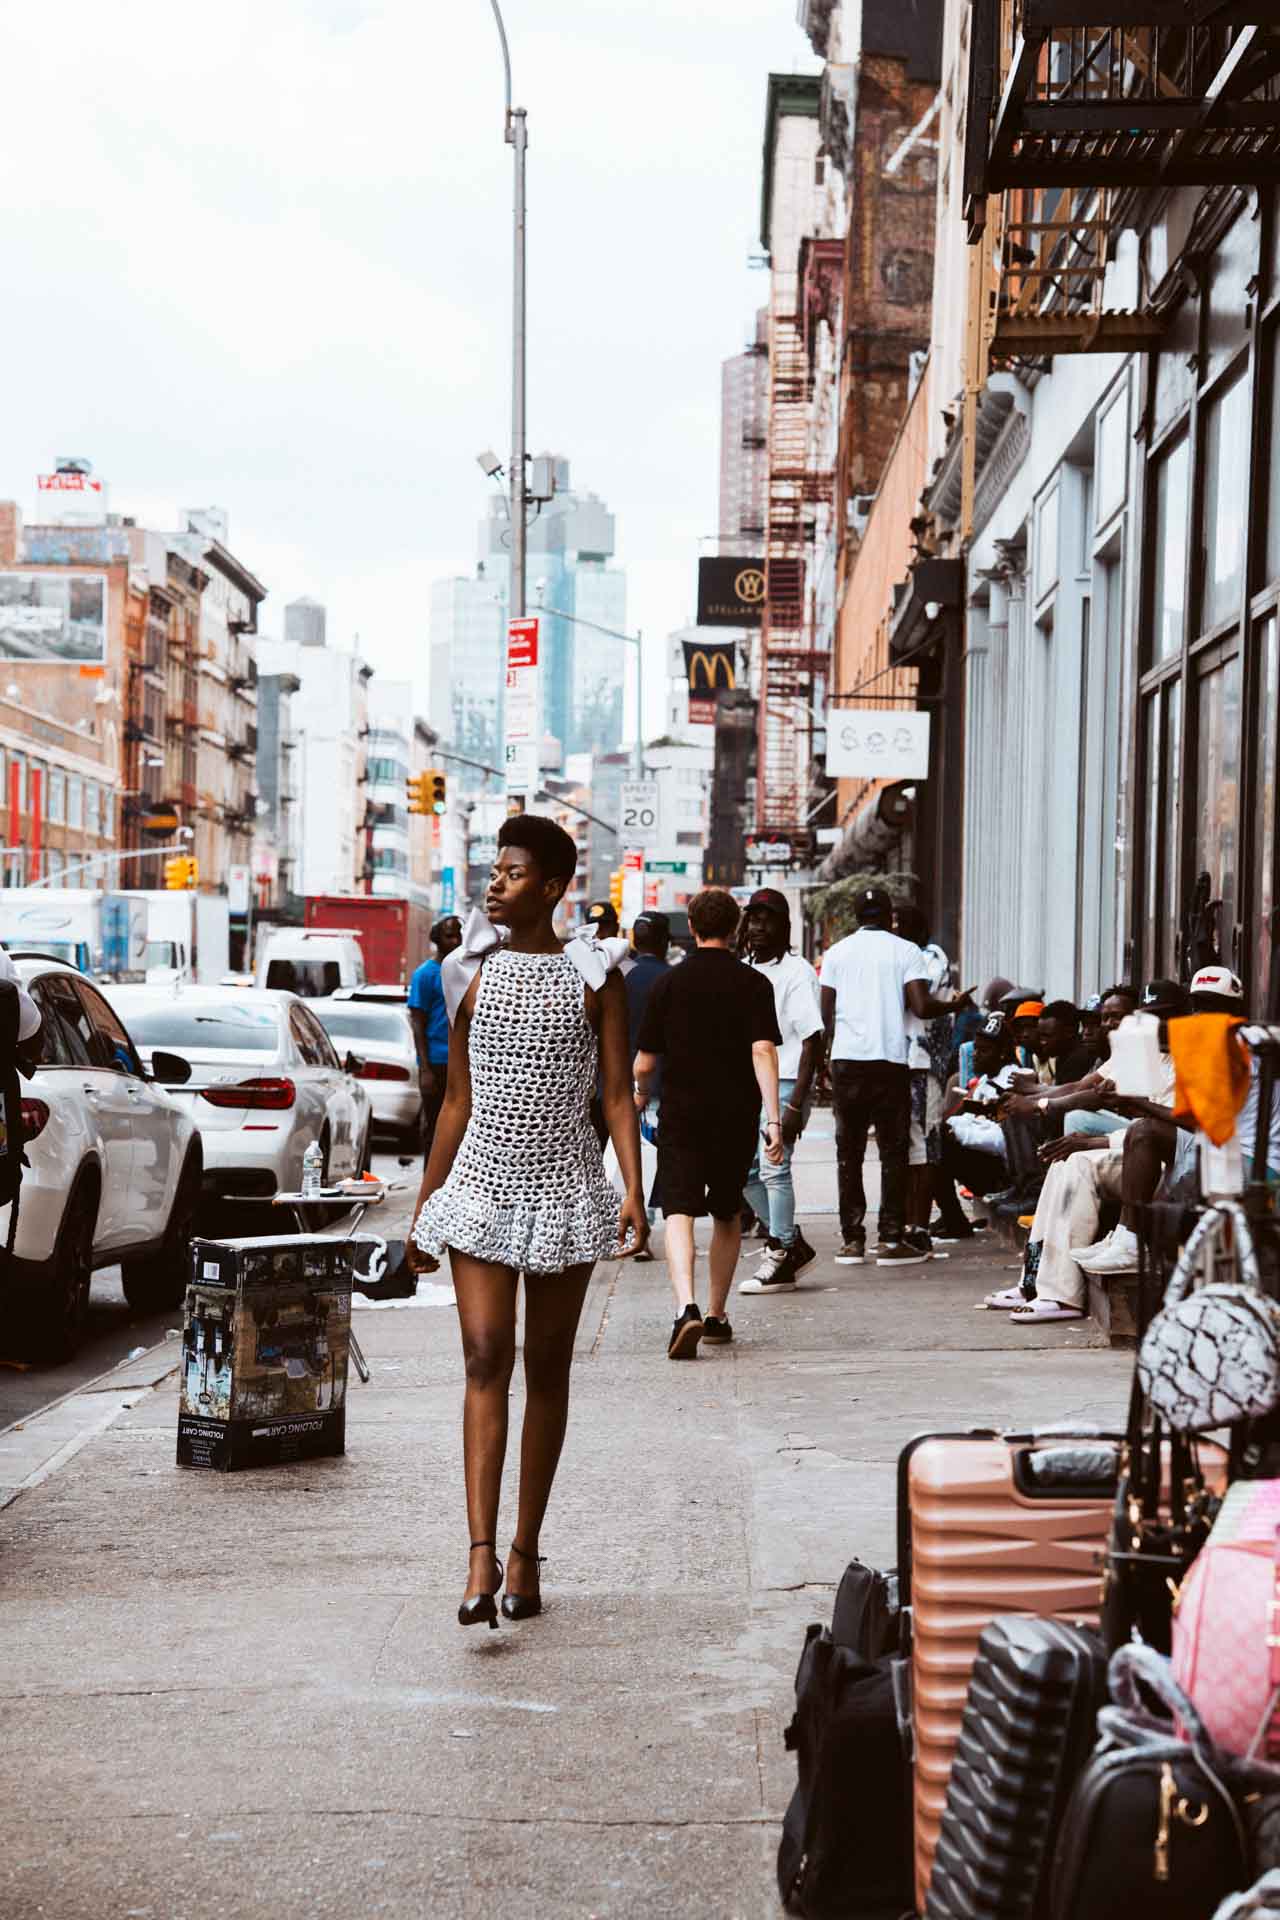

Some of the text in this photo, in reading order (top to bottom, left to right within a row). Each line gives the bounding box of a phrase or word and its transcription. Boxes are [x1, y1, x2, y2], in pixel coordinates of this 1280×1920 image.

[624, 808, 655, 827] 20
[182, 1426, 225, 1440] FOLDING CART
[288, 1420, 324, 1434] FOLDING
